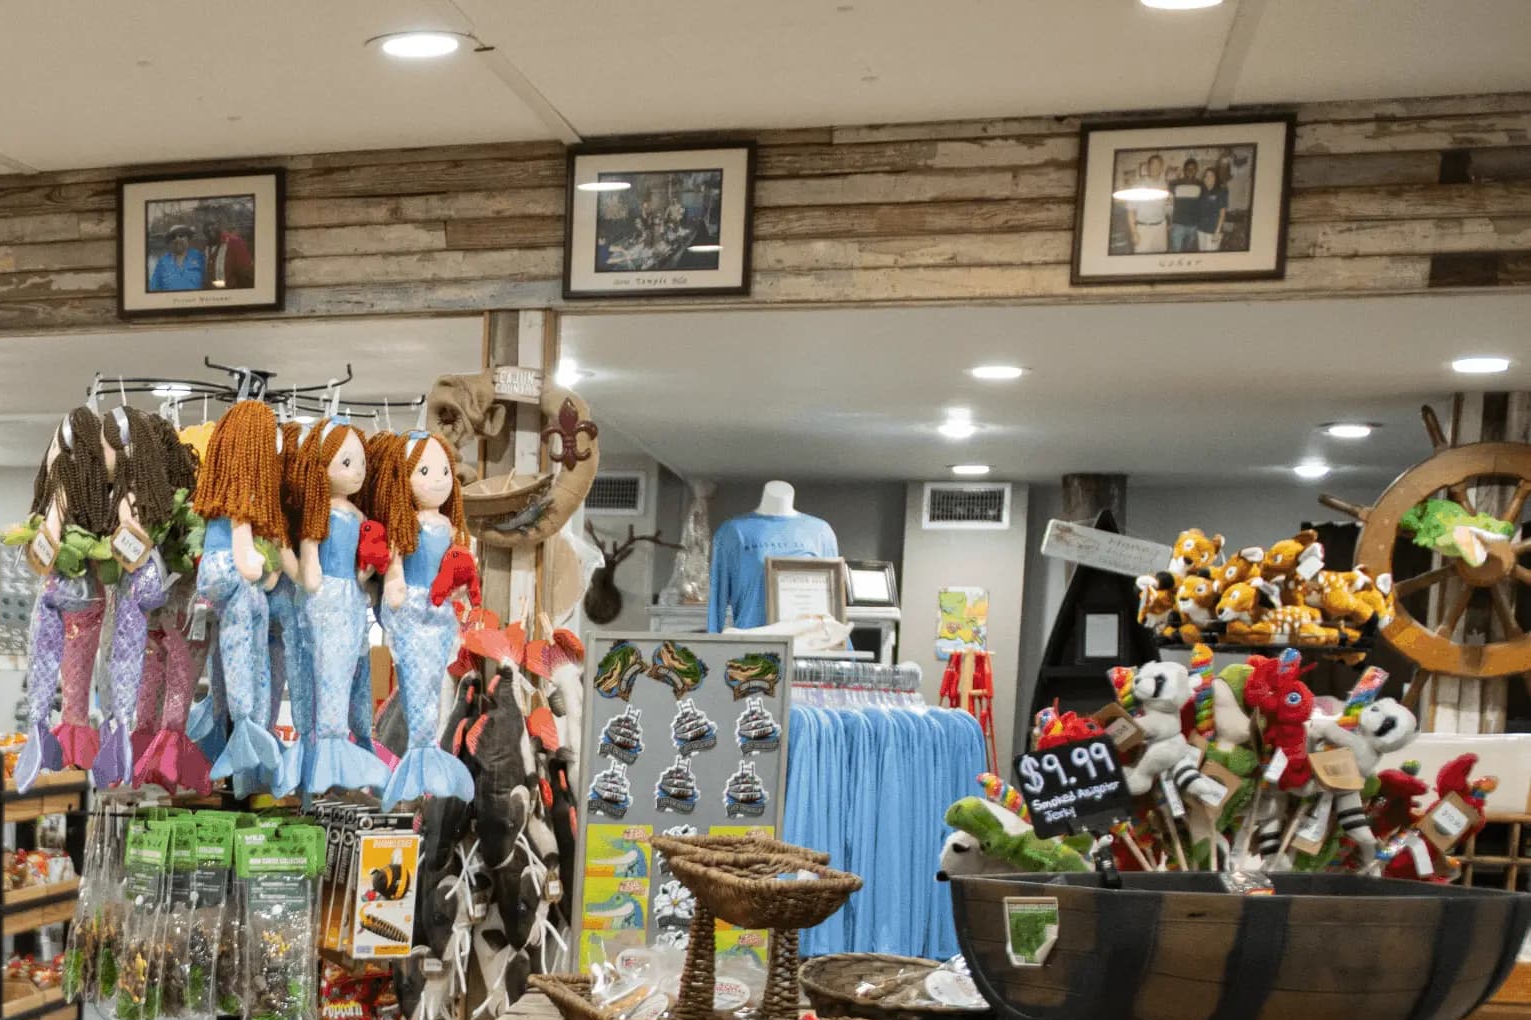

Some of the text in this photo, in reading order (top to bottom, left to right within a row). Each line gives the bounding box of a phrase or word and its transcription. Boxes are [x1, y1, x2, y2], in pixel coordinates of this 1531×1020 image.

[1019, 742, 1116, 794] $9.99
[1032, 791, 1077, 811] Smoked
[1044, 806, 1077, 823] Jerky
[322, 999, 364, 1020] Popcorn
